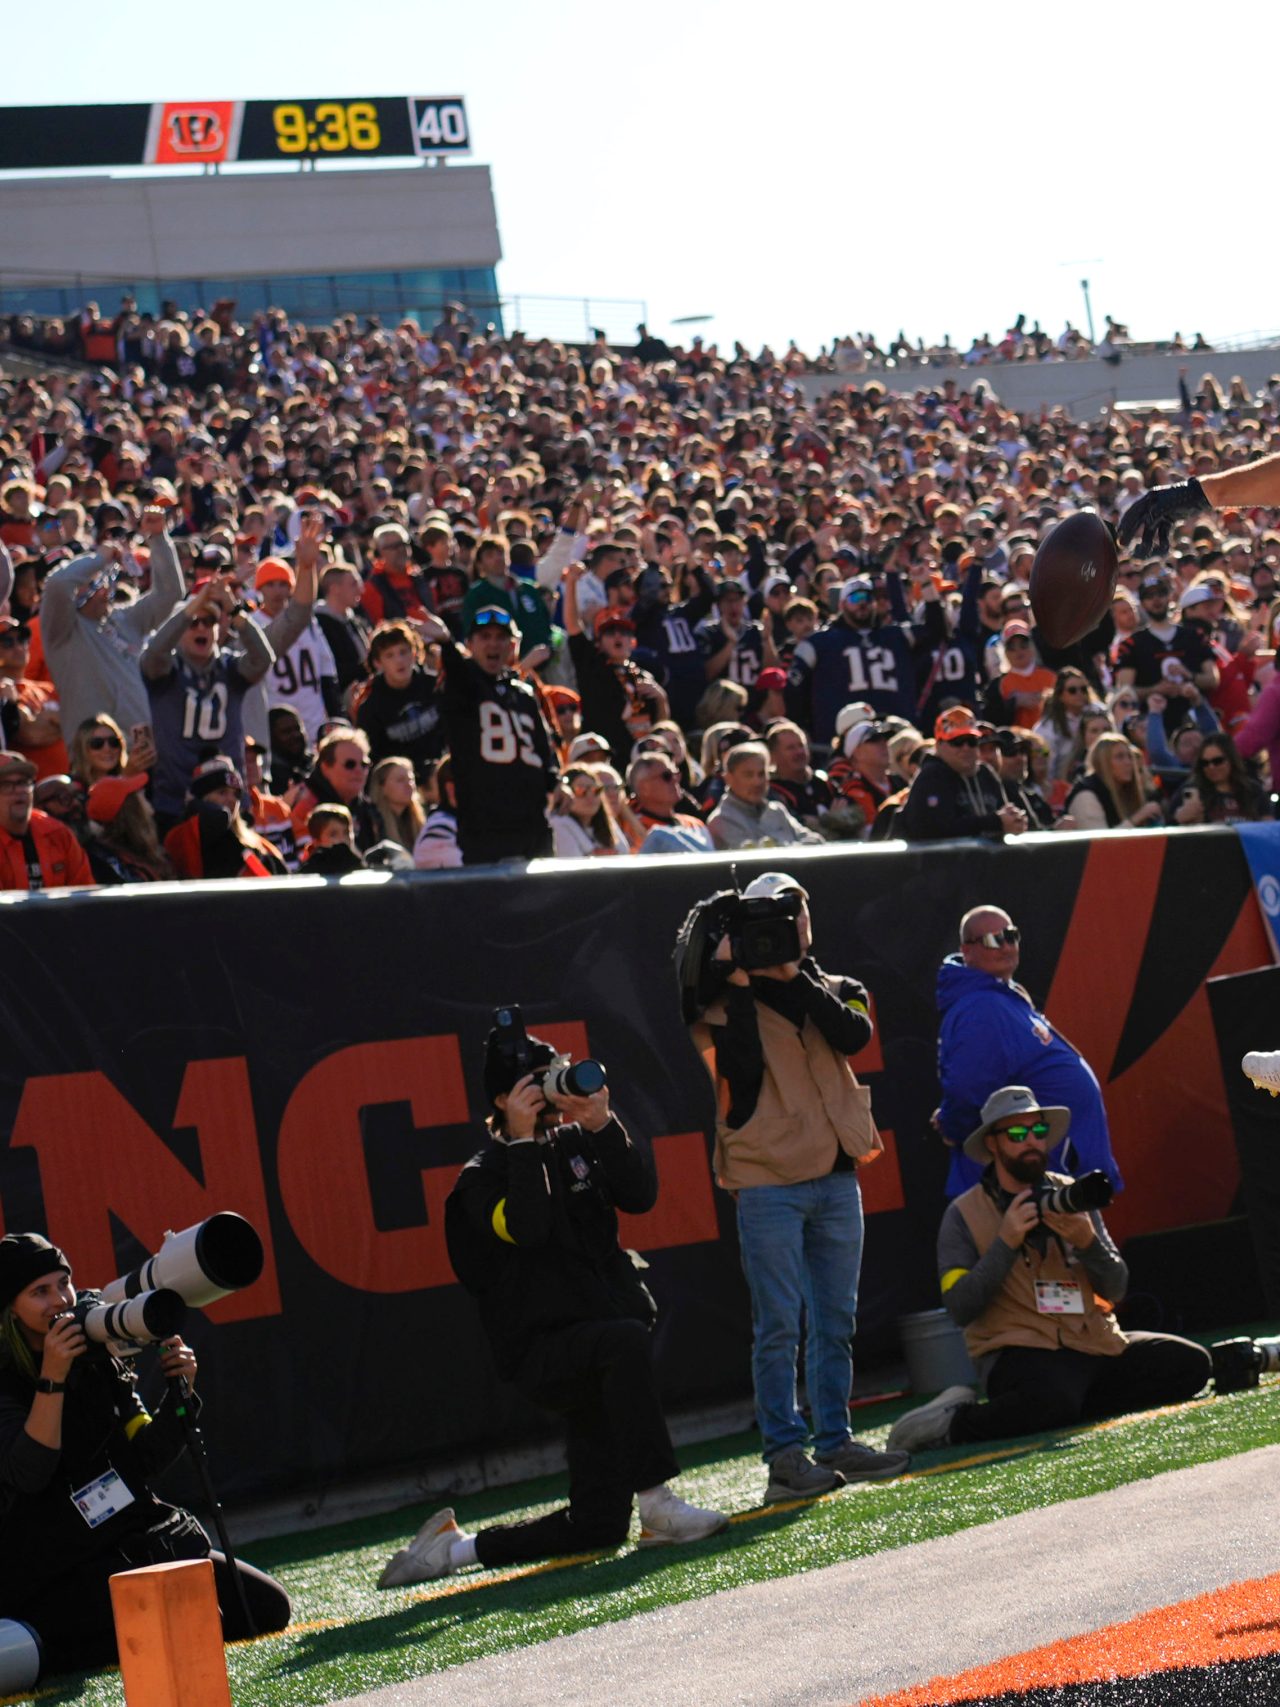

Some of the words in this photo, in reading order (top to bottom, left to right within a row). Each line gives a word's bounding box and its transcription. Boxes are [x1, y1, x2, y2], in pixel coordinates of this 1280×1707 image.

[273, 102, 381, 153] 9:36
[419, 106, 467, 145] 40
[273, 649, 319, 695] 94
[843, 646, 899, 693] 12
[182, 682, 228, 740] 10
[479, 701, 543, 768] 85
